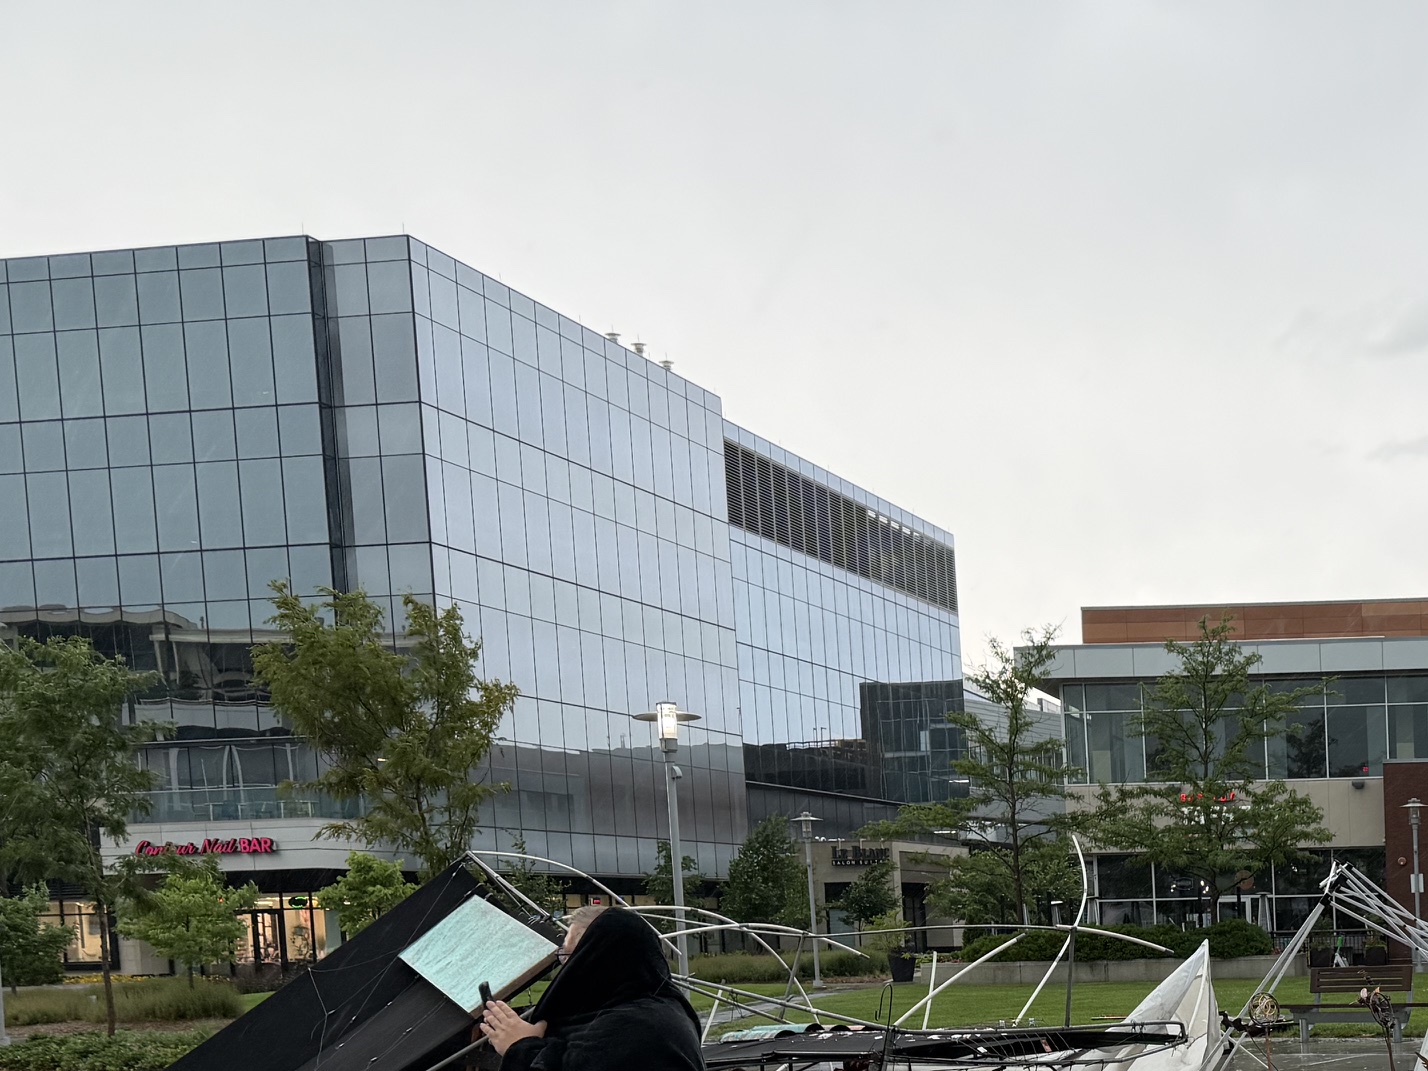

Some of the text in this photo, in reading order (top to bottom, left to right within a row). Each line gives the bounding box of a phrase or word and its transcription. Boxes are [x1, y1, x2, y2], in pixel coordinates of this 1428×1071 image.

[135, 838, 273, 855] Conur Nail BAR
